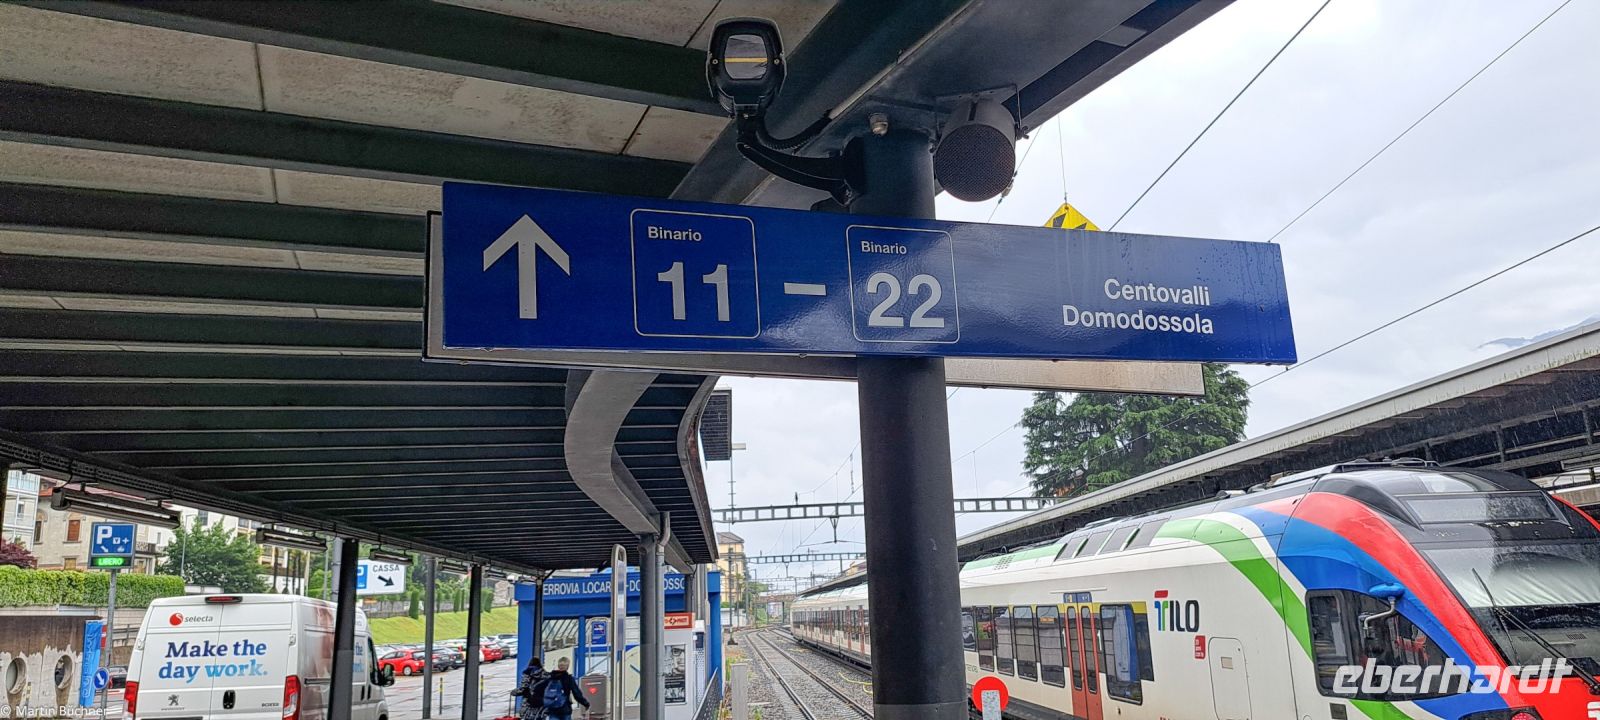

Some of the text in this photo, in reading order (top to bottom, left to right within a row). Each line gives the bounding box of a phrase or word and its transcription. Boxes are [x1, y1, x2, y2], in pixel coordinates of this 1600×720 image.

[647, 226, 702, 241] Binario
[860, 240, 907, 255] Binario
[657, 261, 730, 322] 11
[867, 272, 945, 328] 22
[1104, 278, 1211, 306] Centovalli
[1062, 304, 1214, 335] Domodossola
[96, 525, 113, 545] P
[97, 557, 125, 566] LIBERO
[372, 564, 400, 572] CASSA
[543, 582, 580, 596] ERROVIA
[184, 615, 214, 623] selecta
[1154, 589, 1200, 633] TILO
[164, 639, 267, 658] Make the
[158, 659, 268, 684] day work.
